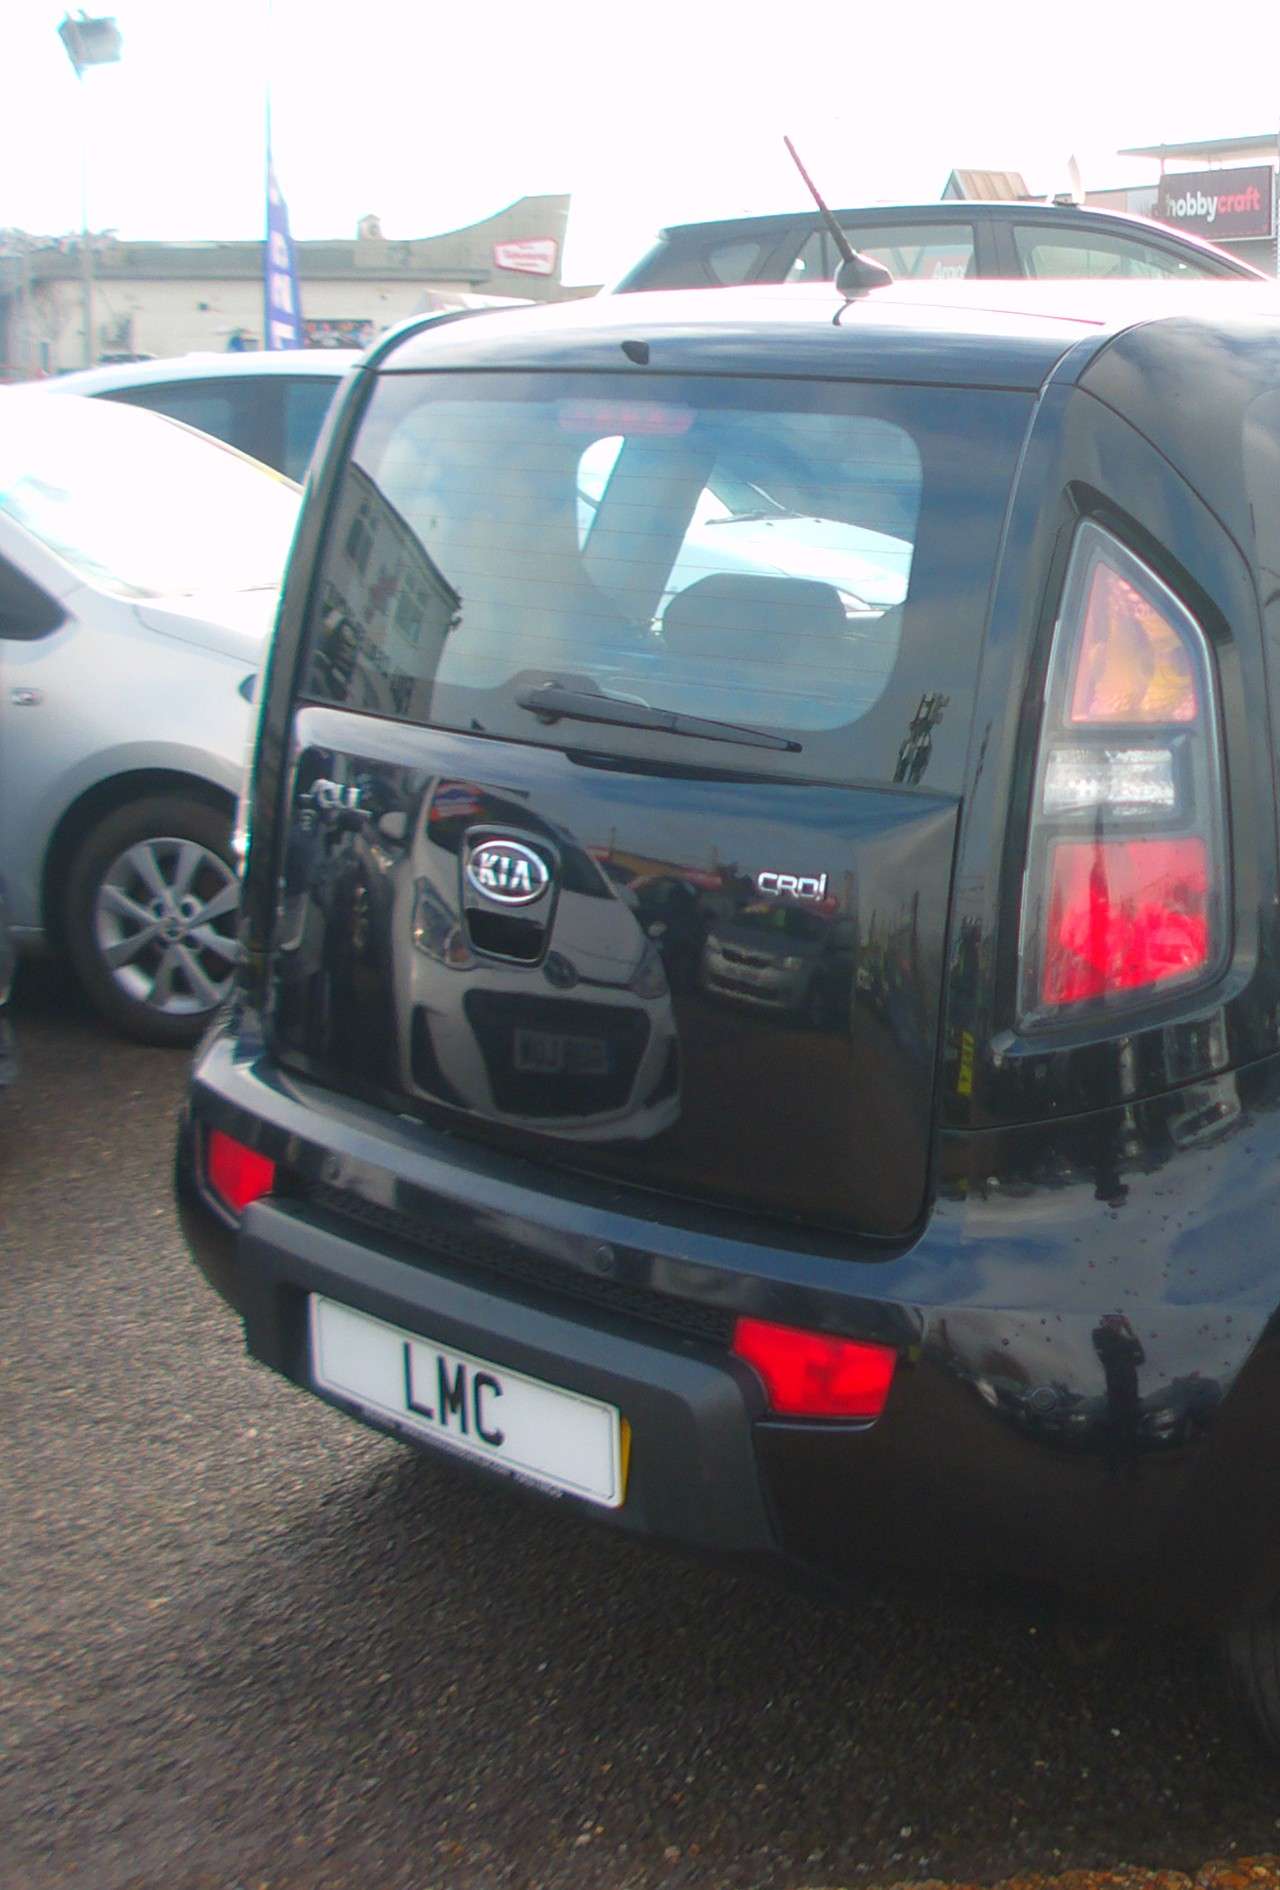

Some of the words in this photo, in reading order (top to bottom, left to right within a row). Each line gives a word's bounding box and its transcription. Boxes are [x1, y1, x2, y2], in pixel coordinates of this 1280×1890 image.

[1165, 184, 1260, 222] hobbycraft
[479, 852, 532, 891] KIA
[403, 1342, 506, 1447] LMC
